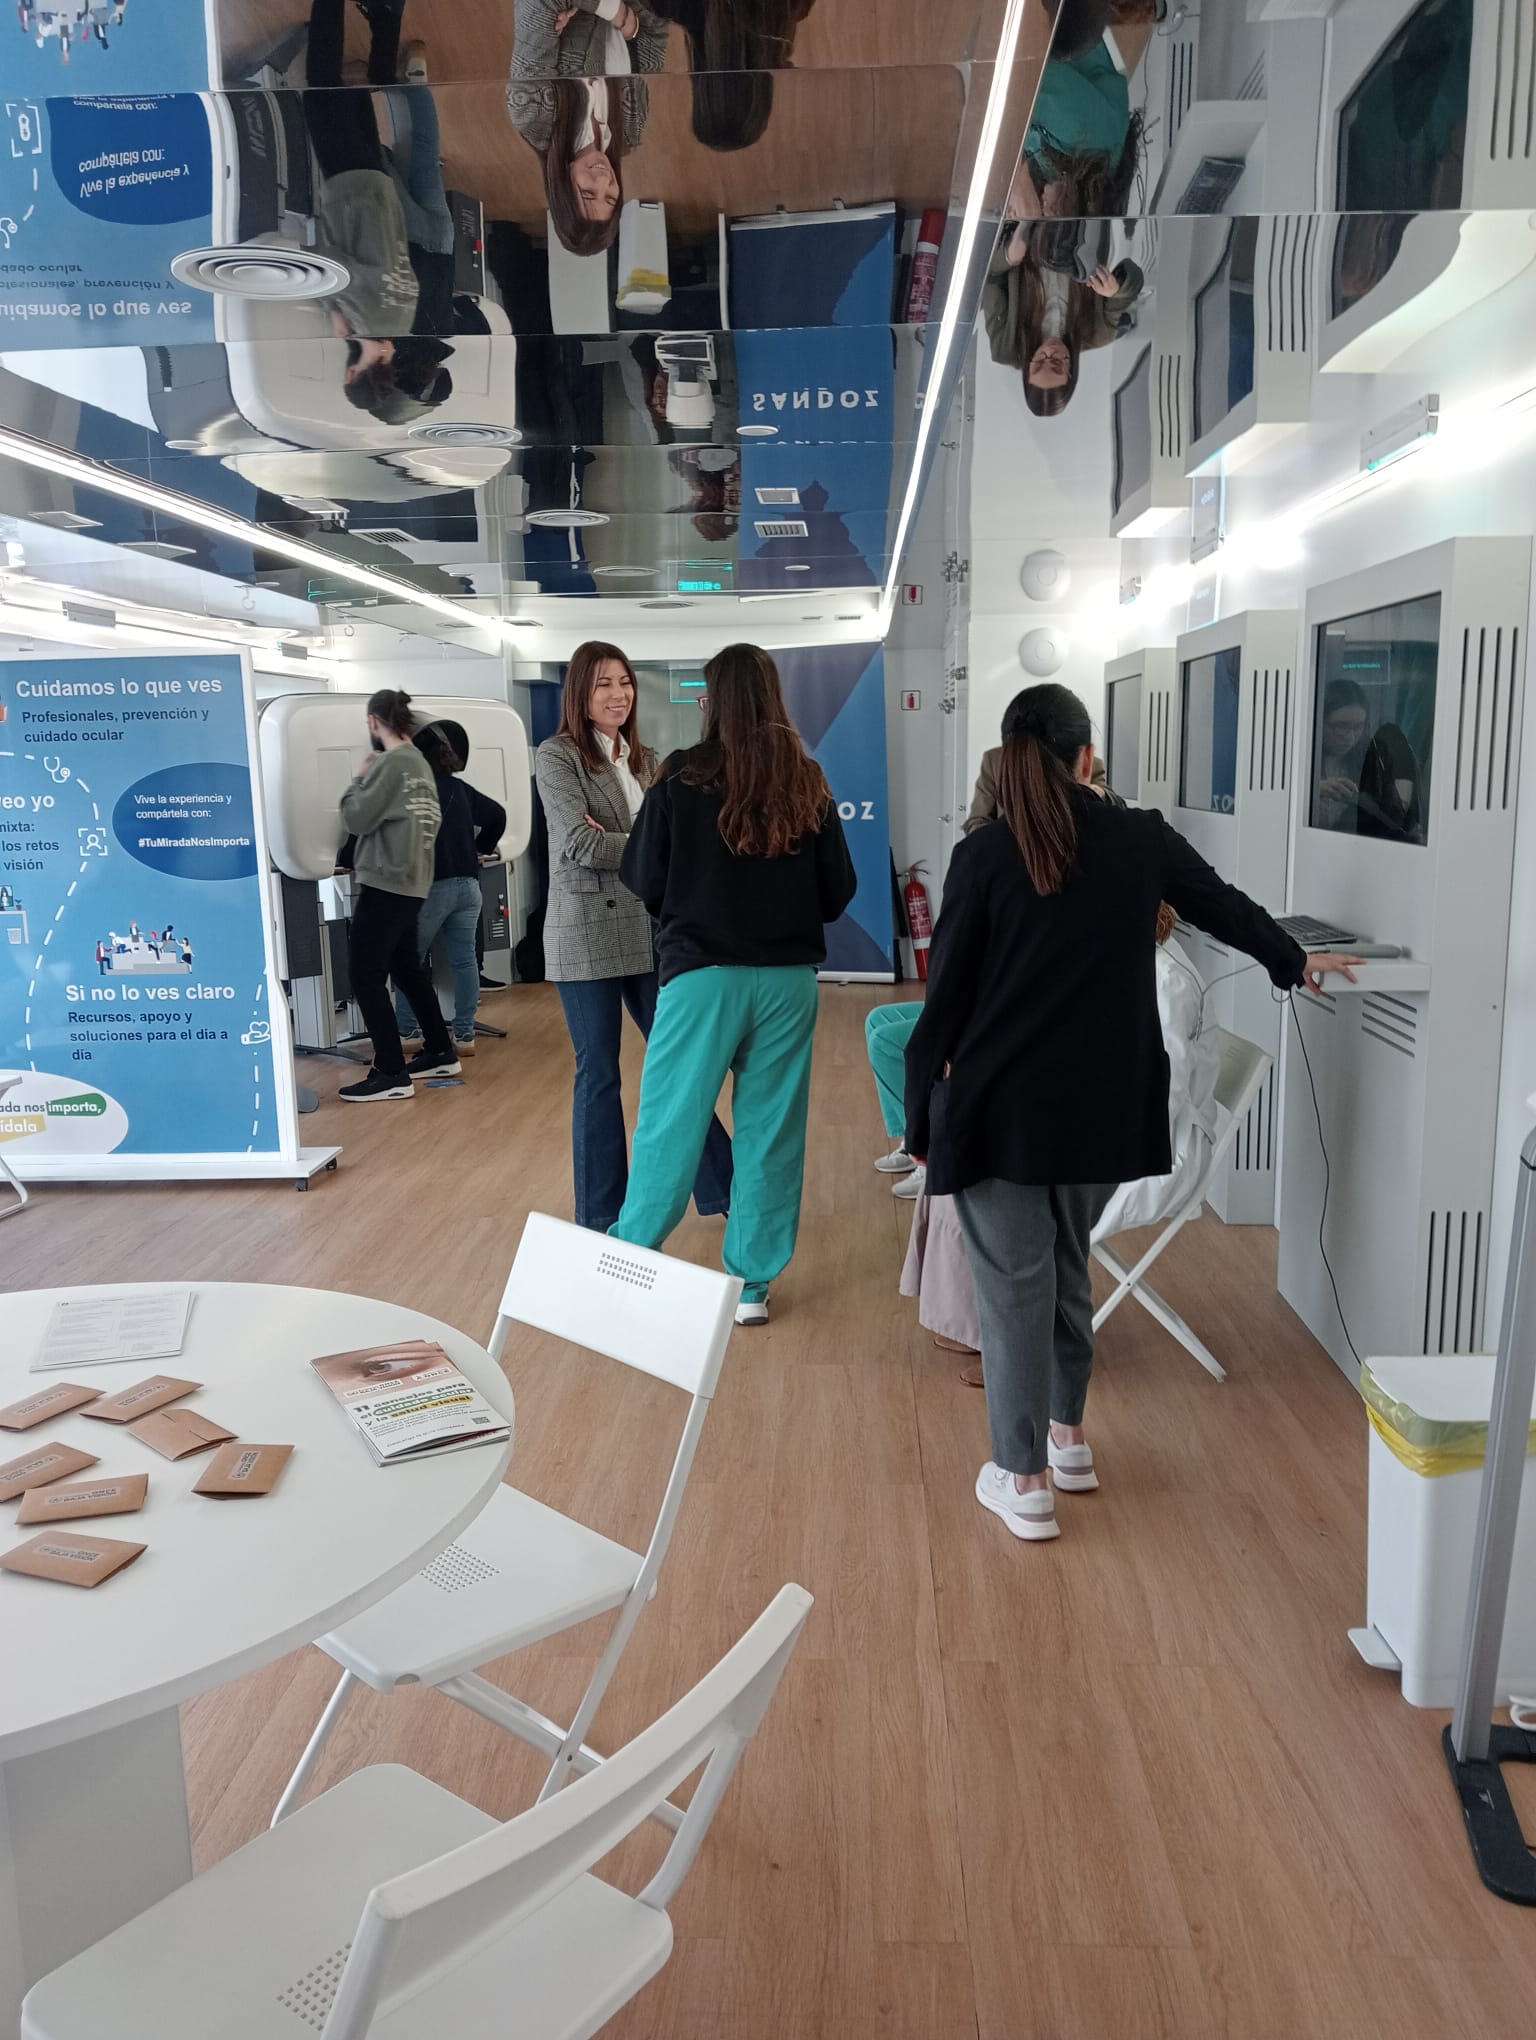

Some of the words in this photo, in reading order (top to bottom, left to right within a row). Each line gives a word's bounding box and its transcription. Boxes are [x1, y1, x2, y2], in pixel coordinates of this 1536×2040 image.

[16, 678, 115, 698] Cuidamos
[121, 678, 139, 694] lo
[145, 680, 182, 698] que
[187, 679, 222, 693] ves
[22, 710, 119, 723] Profesionales,
[122, 707, 198, 724] prevención
[200, 709, 209, 721] y
[24, 730, 78, 743] cuidado
[82, 729, 124, 742] ocular
[0, 796, 26, 809] eo
[31, 795, 55, 812] yo
[134, 794, 155, 804] Vive
[158, 794, 166, 804] la
[169, 793, 224, 805] experiencia
[226, 794, 232, 804] y
[136, 809, 188, 820] compártela
[191, 809, 211, 818] con:
[2, 840, 22, 852] los
[26, 840, 60, 851] retos
[138, 837, 250, 848] #TuMiradaNosImporta
[4, 858, 44, 871] visión
[66, 984, 84, 1001] Si
[91, 987, 116, 1001] no
[122, 984, 140, 1000] lo
[145, 987, 180, 1000] ves
[185, 983, 235, 999] claro
[68, 1011, 136, 1024] Recursos,
[139, 1012, 181, 1024] apoyo
[185, 1012, 192, 1023] y
[70, 1029, 143, 1042] soluciones
[147, 1031, 176, 1043] para
[180, 1029, 192, 1040] el
[220, 1030, 228, 1040] a
[72, 1049, 92, 1061] día
[25, 1103, 45, 1113] nos
[48, 1101, 101, 1115] importa,
[374, 1390, 434, 1408] consejos
[436, 1382, 466, 1393] para
[360, 1412, 373, 1420] el
[364, 1420, 373, 1428] y
[391, 1404, 429, 1418] salud
[431, 1395, 471, 1408] visual
